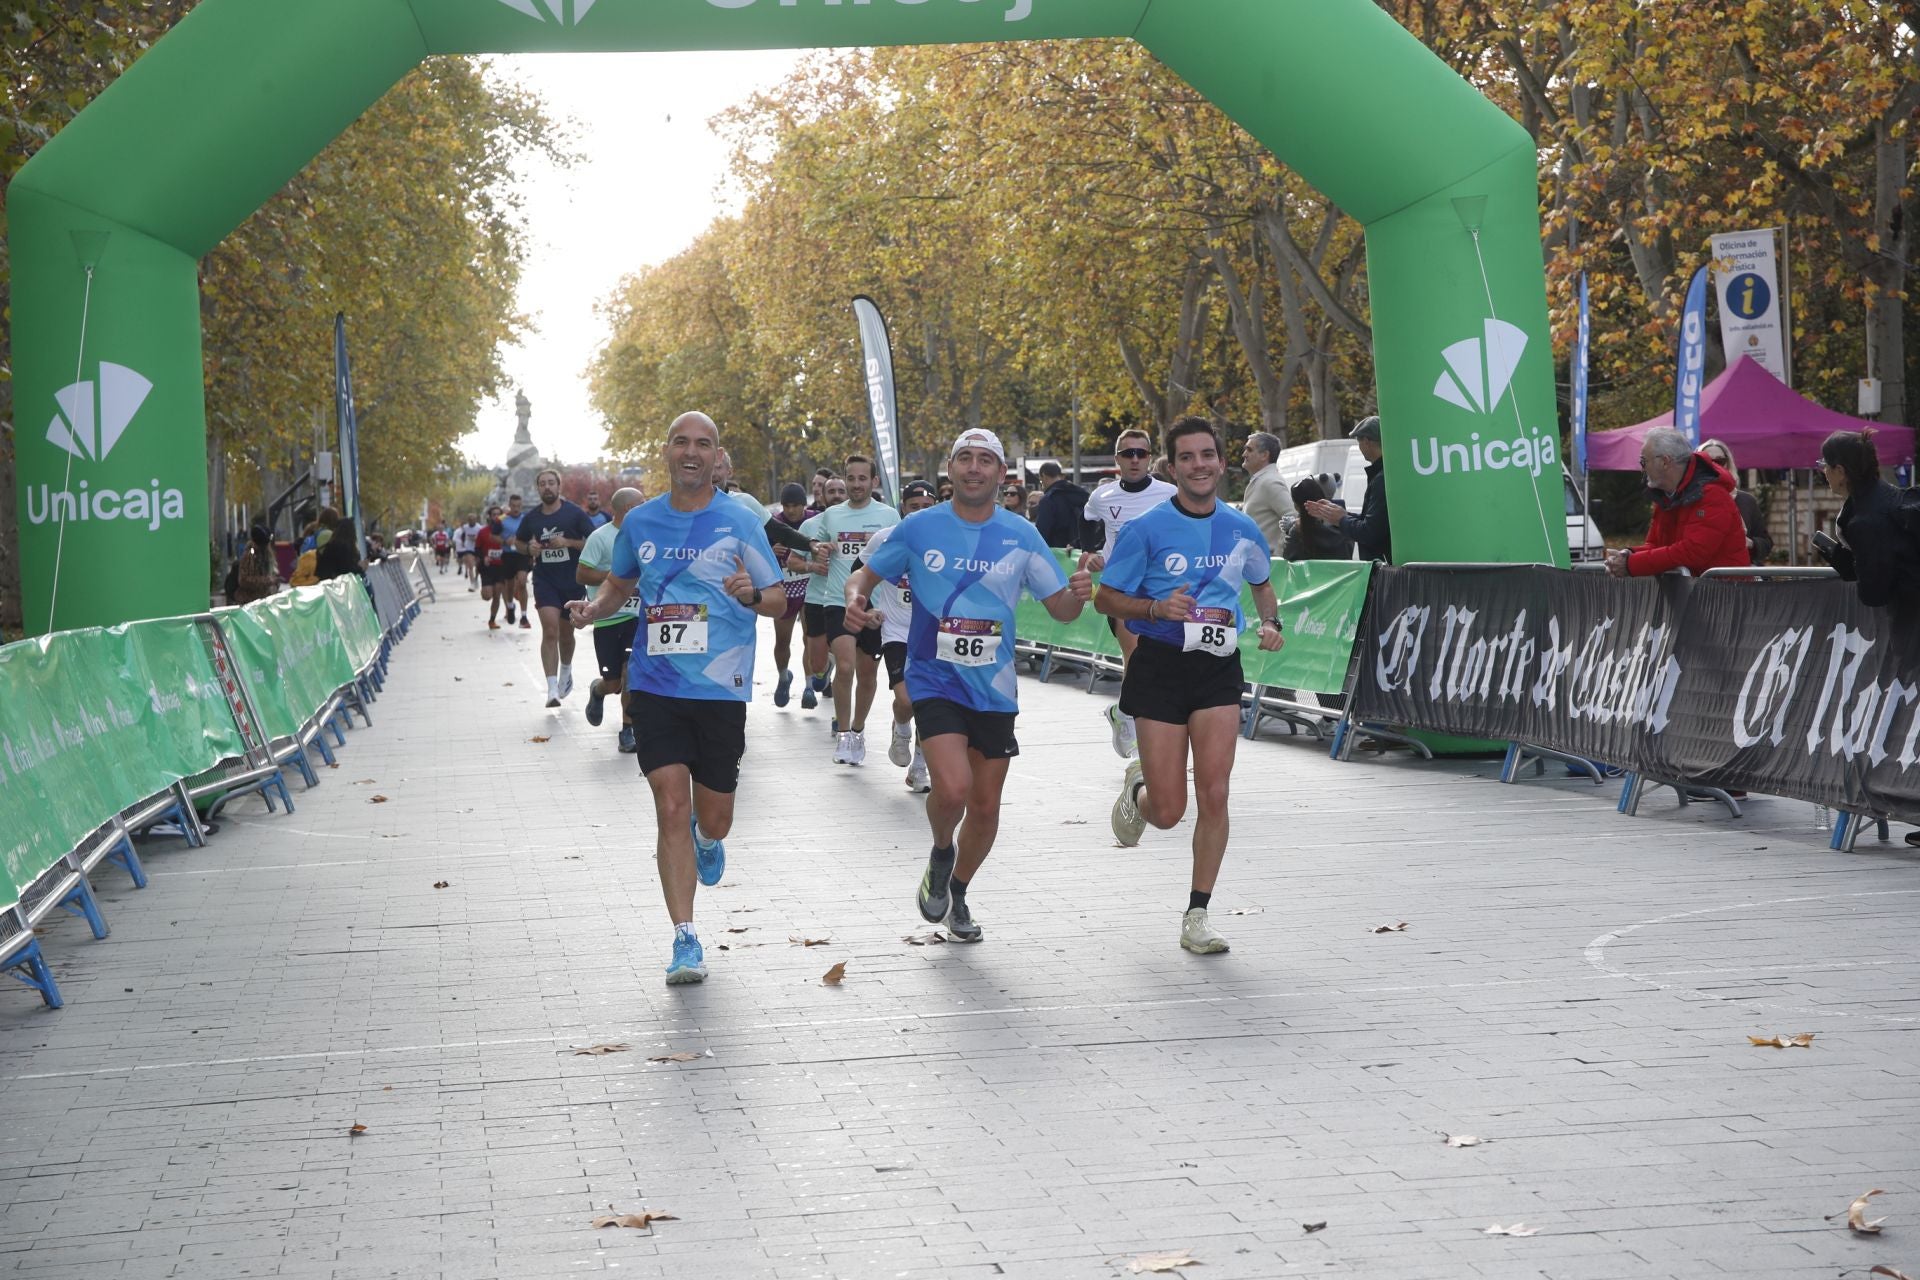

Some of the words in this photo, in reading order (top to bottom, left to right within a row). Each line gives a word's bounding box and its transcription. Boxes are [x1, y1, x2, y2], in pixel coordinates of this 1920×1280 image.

[1719, 241, 1746, 251] Oficina
[1748, 240, 1757, 248] de
[1411, 426, 1555, 477] Unicaja
[27, 478, 184, 531] Unicaja
[545, 549, 564, 559] 640
[662, 547, 727, 562] ZURICH
[953, 557, 1015, 575] ZURICH
[660, 624, 688, 644] 87
[1201, 626, 1226, 647] 85
[954, 637, 984, 657] 86
[1377, 604, 1430, 697] El
[1429, 604, 1535, 704] Norte
[1532, 614, 1574, 712] de
[1732, 624, 1814, 749] El
[1806, 622, 1920, 775] Nor
